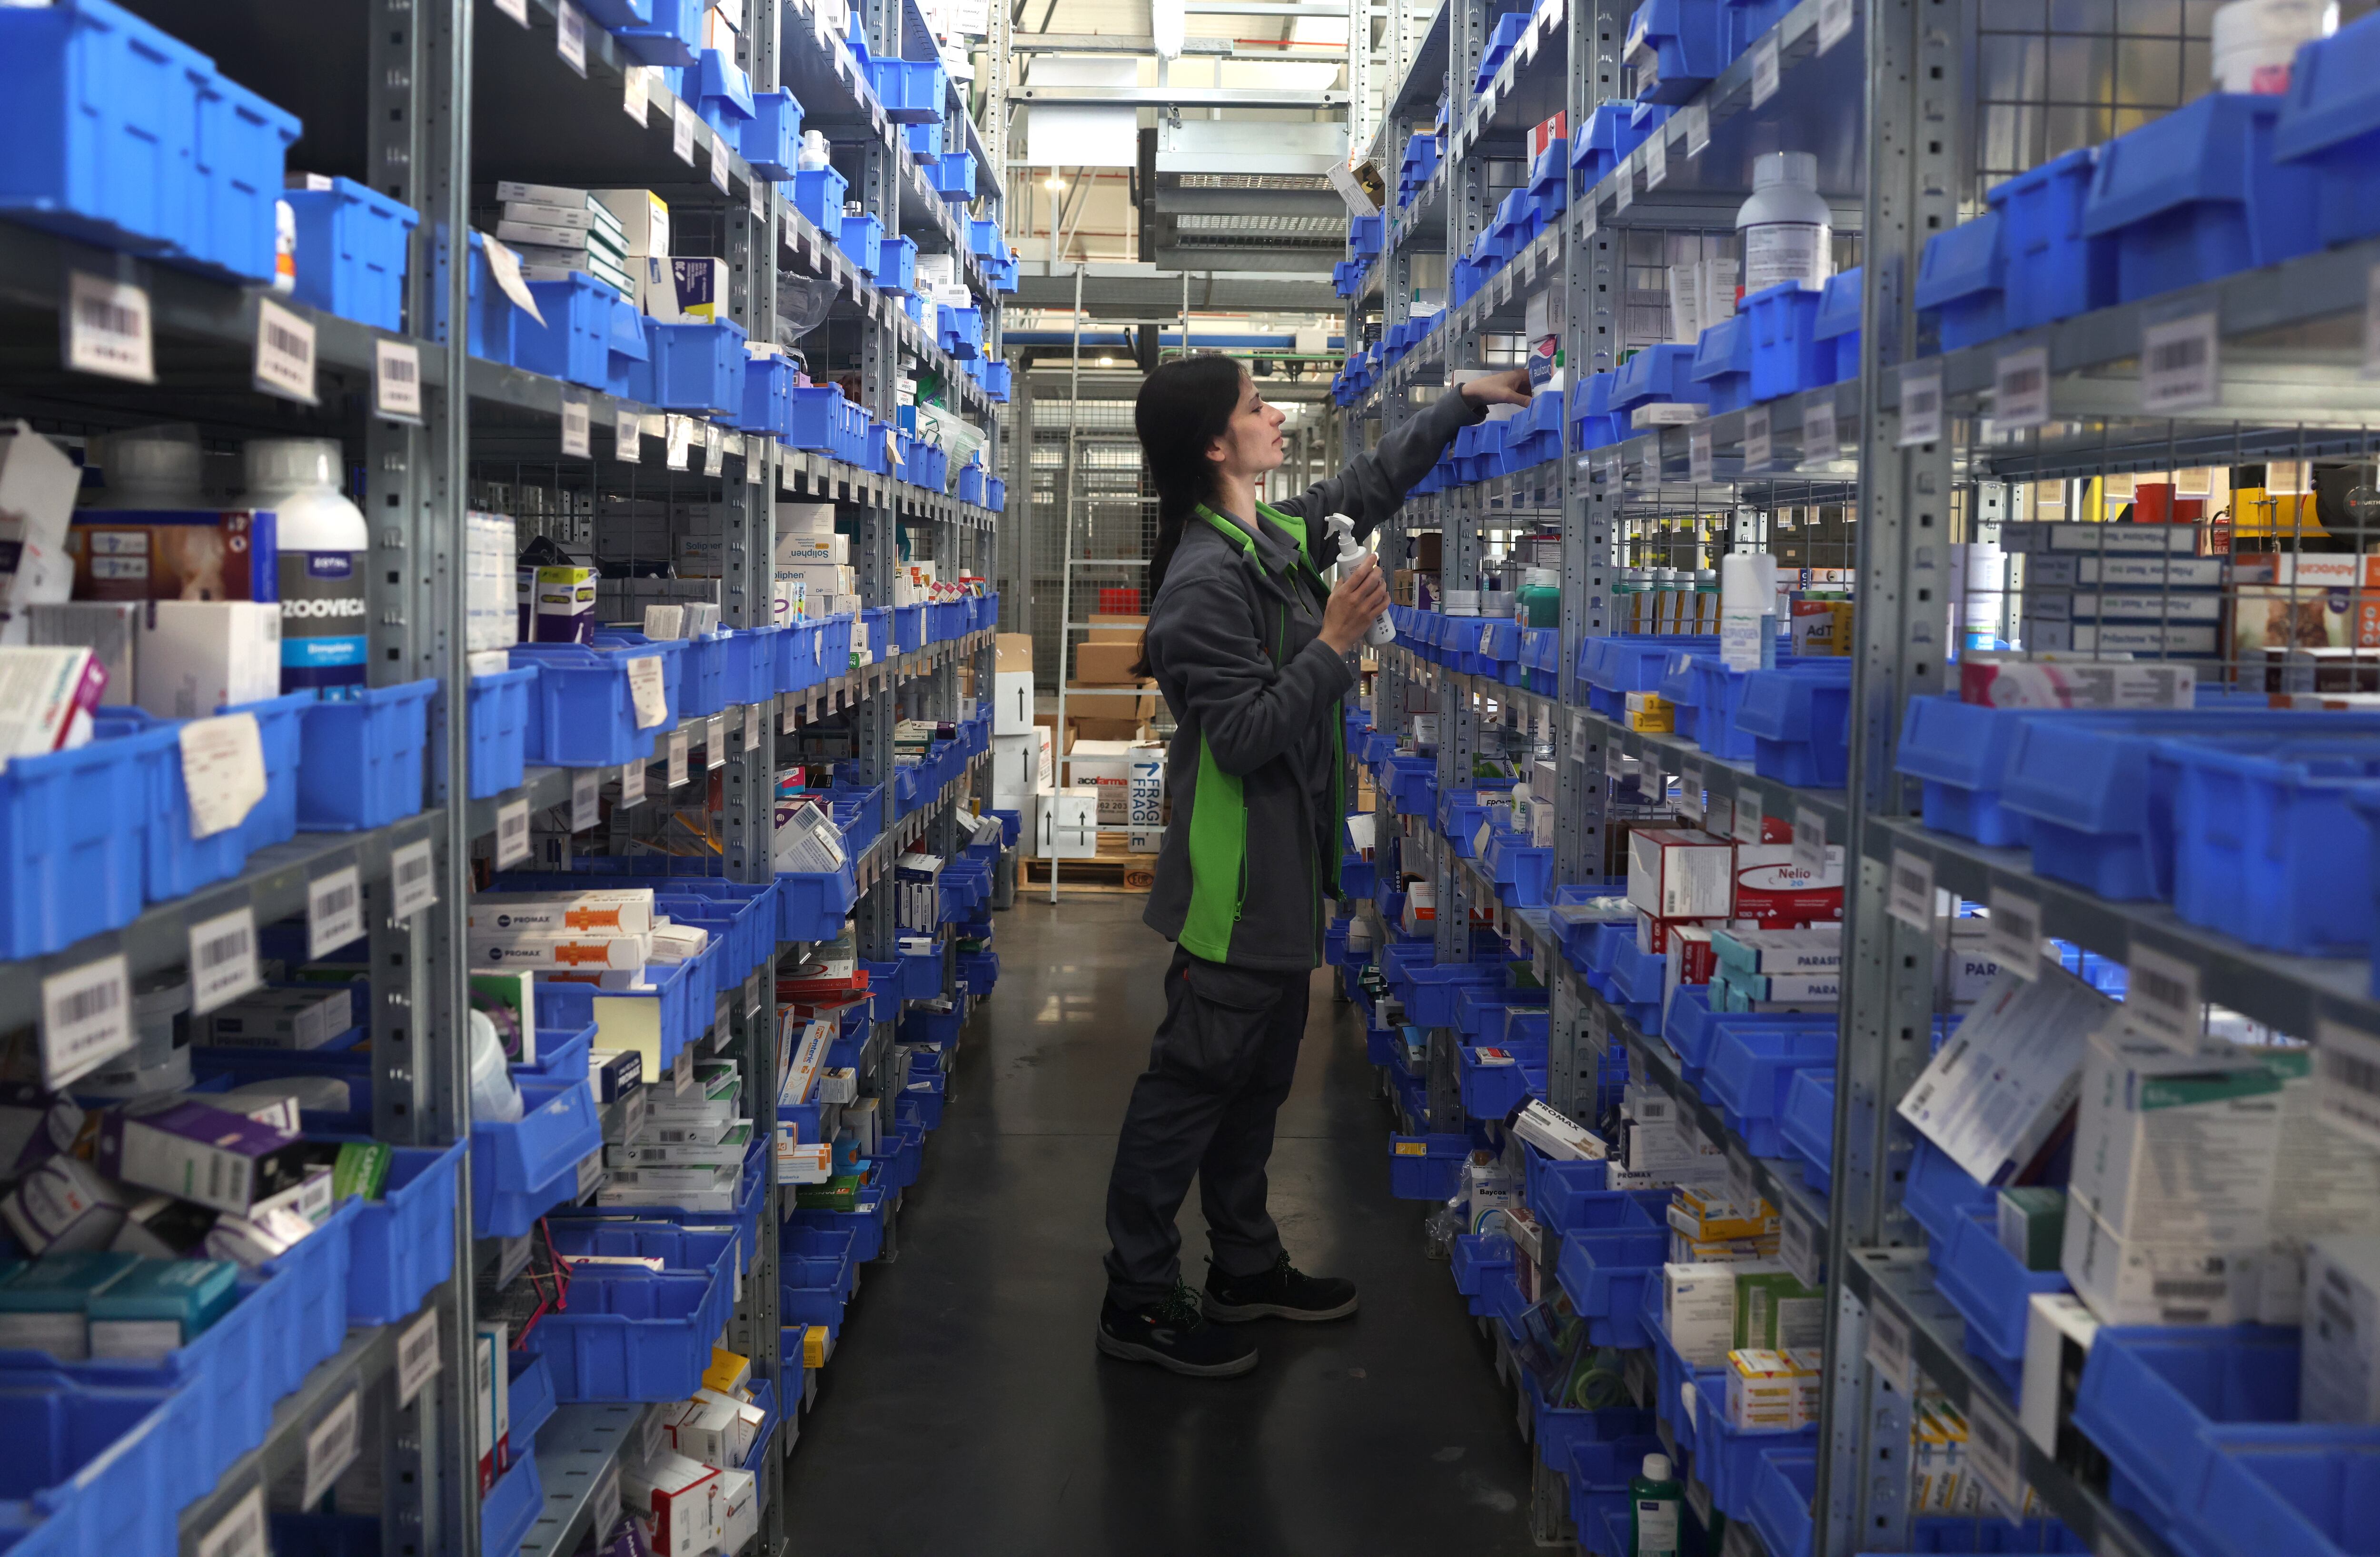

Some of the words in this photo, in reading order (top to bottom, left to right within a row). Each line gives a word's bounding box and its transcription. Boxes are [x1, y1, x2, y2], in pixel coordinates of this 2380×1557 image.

[675, 261, 685, 271] 30
[791, 550, 829, 558] Soliphen
[783, 769, 796, 777] onsior
[1077, 776, 1127, 785] acofarma
[1132, 779, 1146, 846] FRAGIE
[1146, 779, 1160, 836] FRAGI
[1778, 868, 1811, 879] Nelio
[1965, 962, 1997, 975] PAR
[1808, 985, 1838, 994] PARA
[1536, 1101, 1579, 1131] PROMAX
